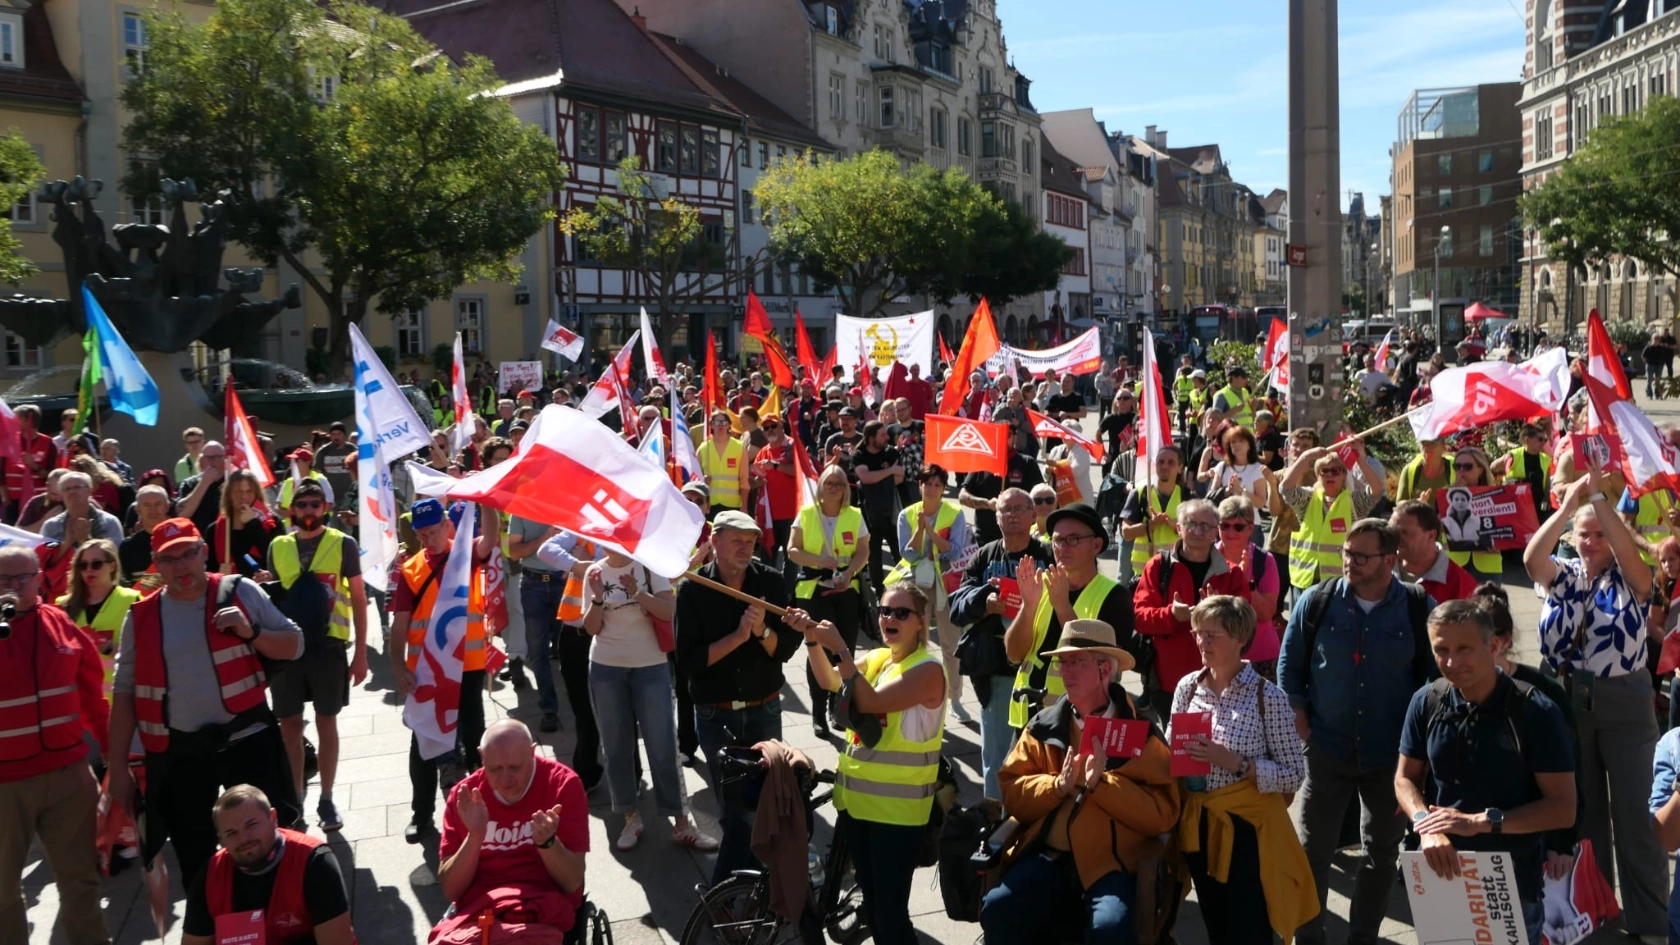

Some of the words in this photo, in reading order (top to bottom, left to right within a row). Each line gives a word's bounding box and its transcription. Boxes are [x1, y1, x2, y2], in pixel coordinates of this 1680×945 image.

[416, 505, 433, 514] EVG
[1471, 499, 1491, 510] Hart
[1472, 504, 1515, 516] verdient!
[1483, 517, 1493, 529] 8
[964, 547, 978, 556] Ha
[1411, 860, 1425, 883] attac
[1481, 876, 1500, 920] statt
